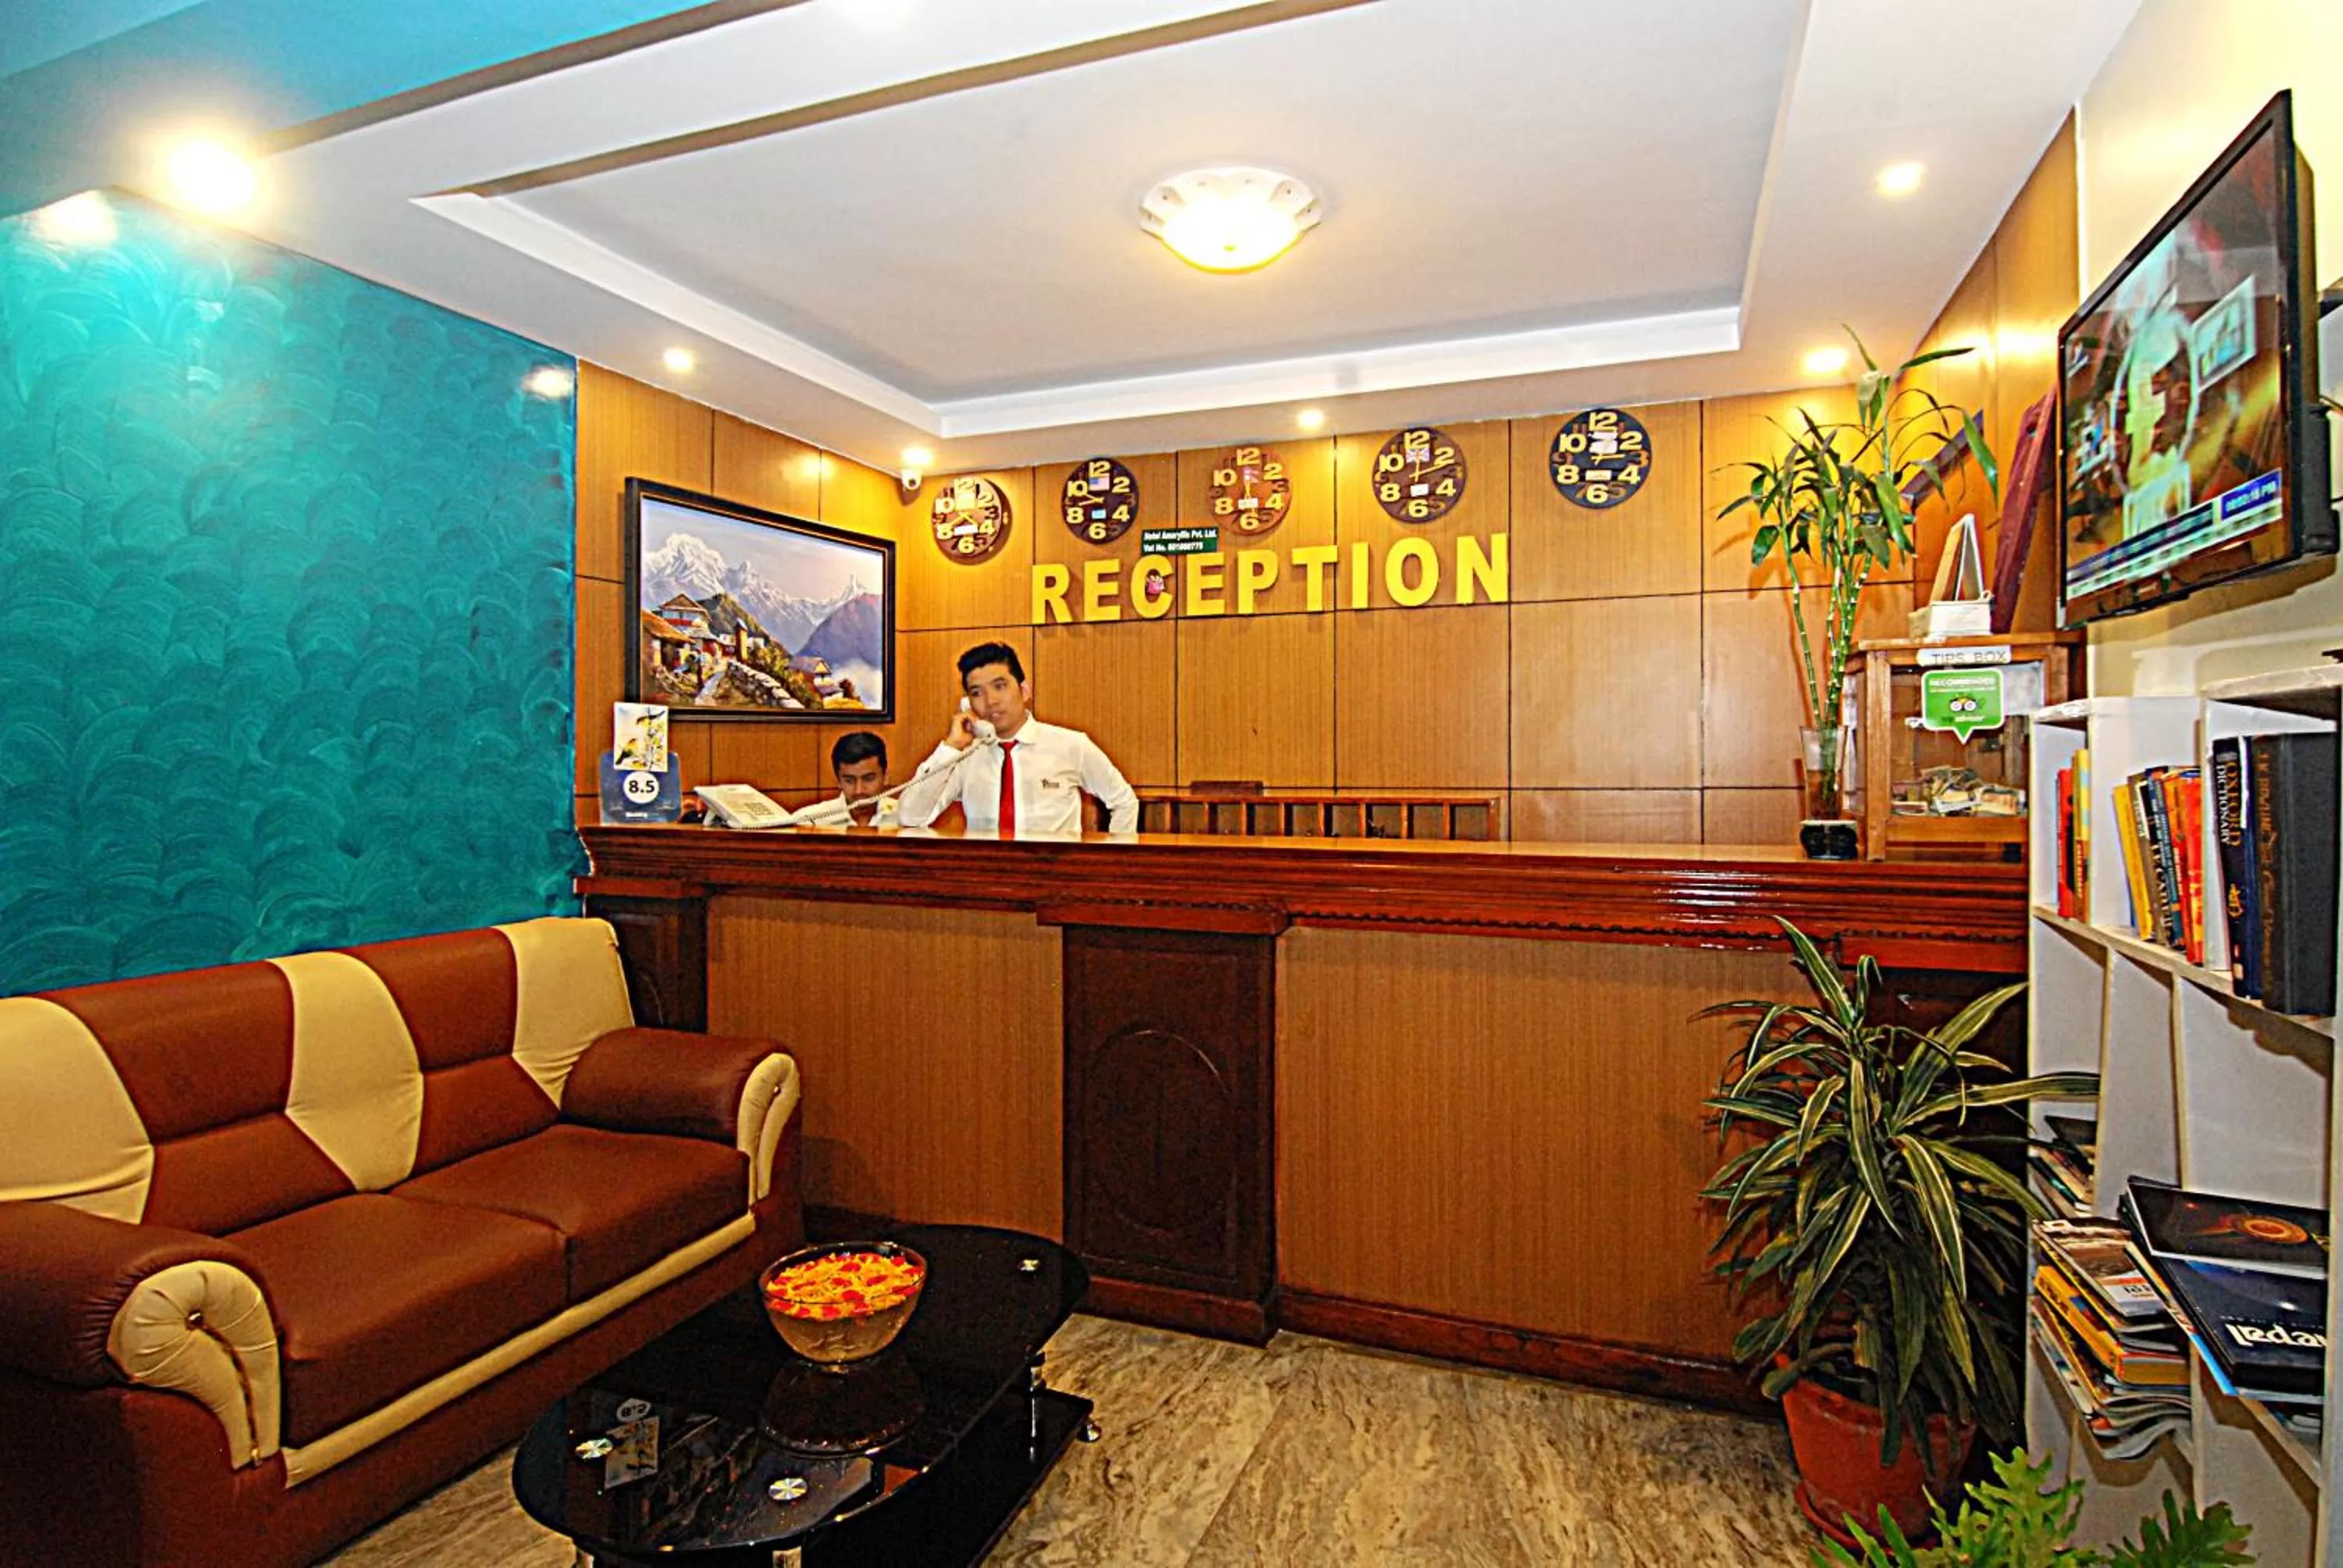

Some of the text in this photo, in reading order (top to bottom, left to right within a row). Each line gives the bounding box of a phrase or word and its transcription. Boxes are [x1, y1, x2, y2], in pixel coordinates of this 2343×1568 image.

[1589, 412, 1617, 432] 12
[1404, 430, 1430, 450] 12
[1559, 433, 1587, 453] 10
[1620, 430, 1642, 451] 2
[1236, 447, 1260, 465] 12
[1379, 453, 1404, 472] 10
[1434, 447, 1455, 466] 2
[1089, 461, 1111, 478] 12
[1213, 469, 1238, 486] 10
[1263, 462, 1283, 480] 2
[1557, 465, 1579, 484] 8
[1617, 465, 1640, 484] 4
[1067, 480, 1088, 497] 10
[1112, 476, 1130, 494] 2
[1380, 483, 1400, 502] 8
[1435, 478, 1457, 497] 4
[1587, 484, 1608, 504] 6
[935, 497, 955, 514] 10
[978, 492, 994, 508] 2
[1214, 497, 1233, 515] 8
[1265, 493, 1285, 510] 4
[1408, 499, 1428, 518] 6
[1067, 507, 1084, 524] 8
[1112, 504, 1130, 522] 4
[1239, 512, 1260, 530] 6
[937, 524, 954, 540] 8
[979, 519, 996, 536] 4
[1089, 522, 1107, 540] 6
[1143, 531, 1161, 540] Hotel
[959, 536, 975, 553] 6
[1032, 533, 1509, 625] RECEPTION
[1931, 650, 2006, 665] TIPS BOX
[629, 779, 655, 794] 8.5
[2217, 764, 2231, 844] DICTIONARY
[2225, 762, 2242, 846] OXFORD
